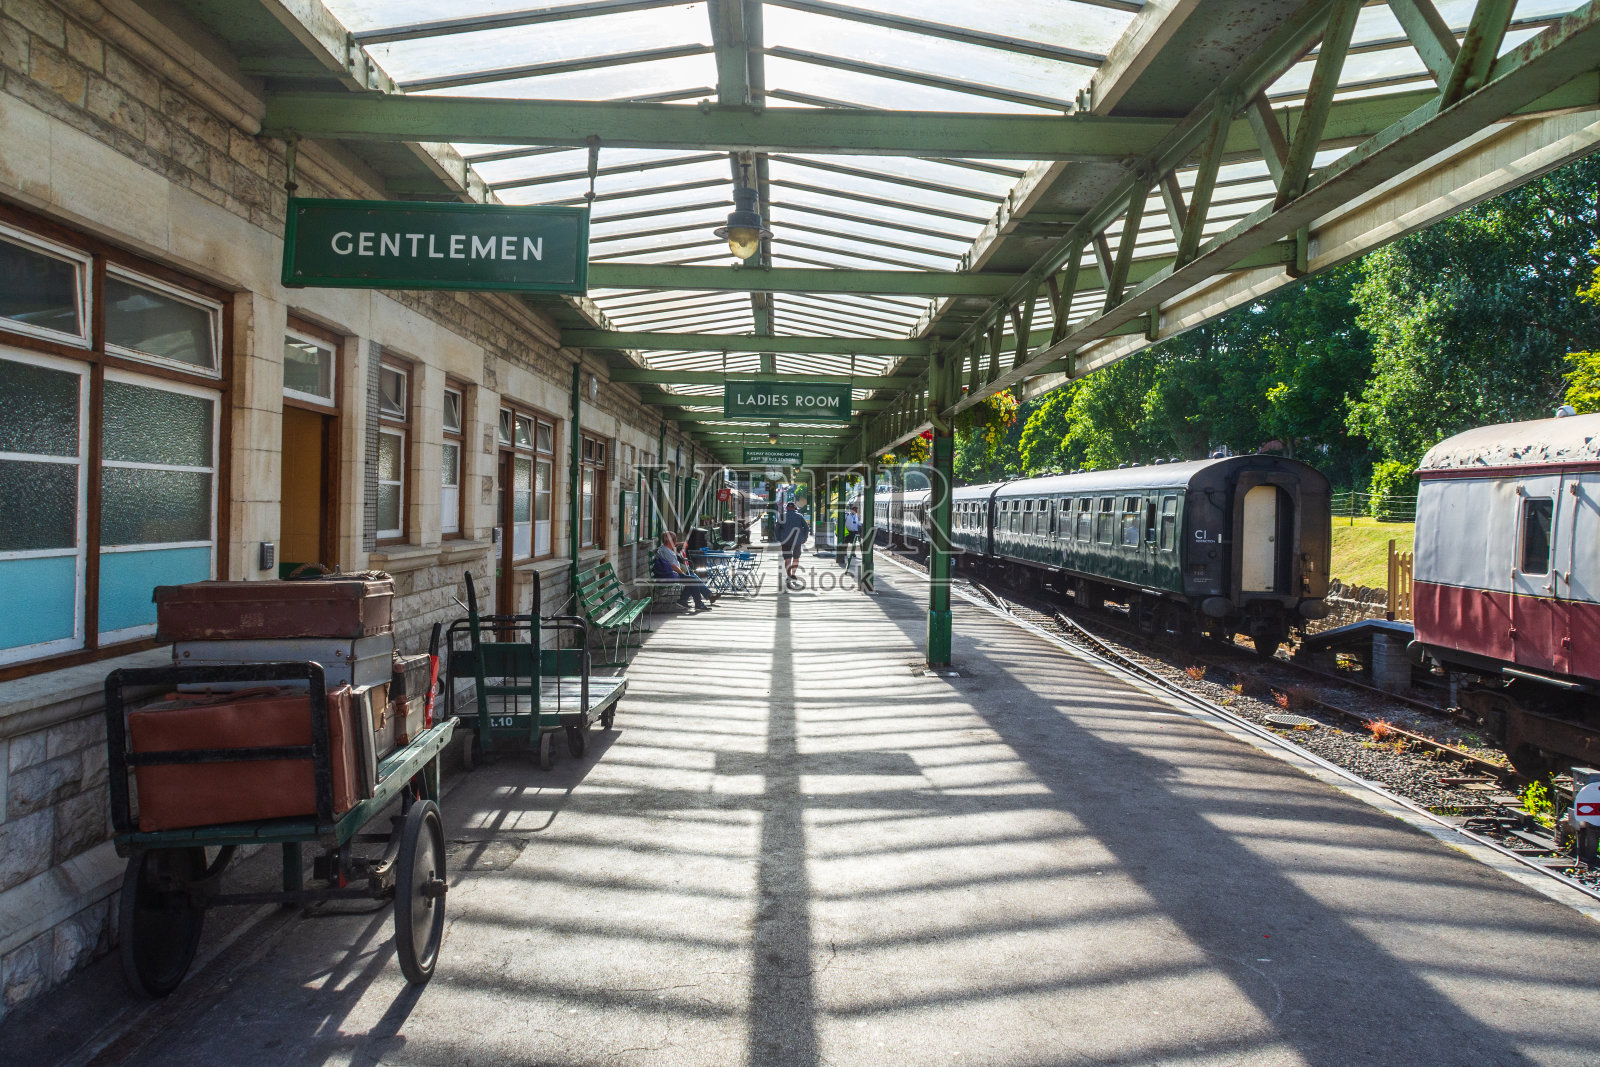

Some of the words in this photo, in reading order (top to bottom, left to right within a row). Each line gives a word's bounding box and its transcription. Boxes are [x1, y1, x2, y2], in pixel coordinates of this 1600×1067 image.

[330, 230, 544, 261] GENTLEMEN
[737, 393, 789, 406] LADIES
[795, 395, 840, 408] ROOM
